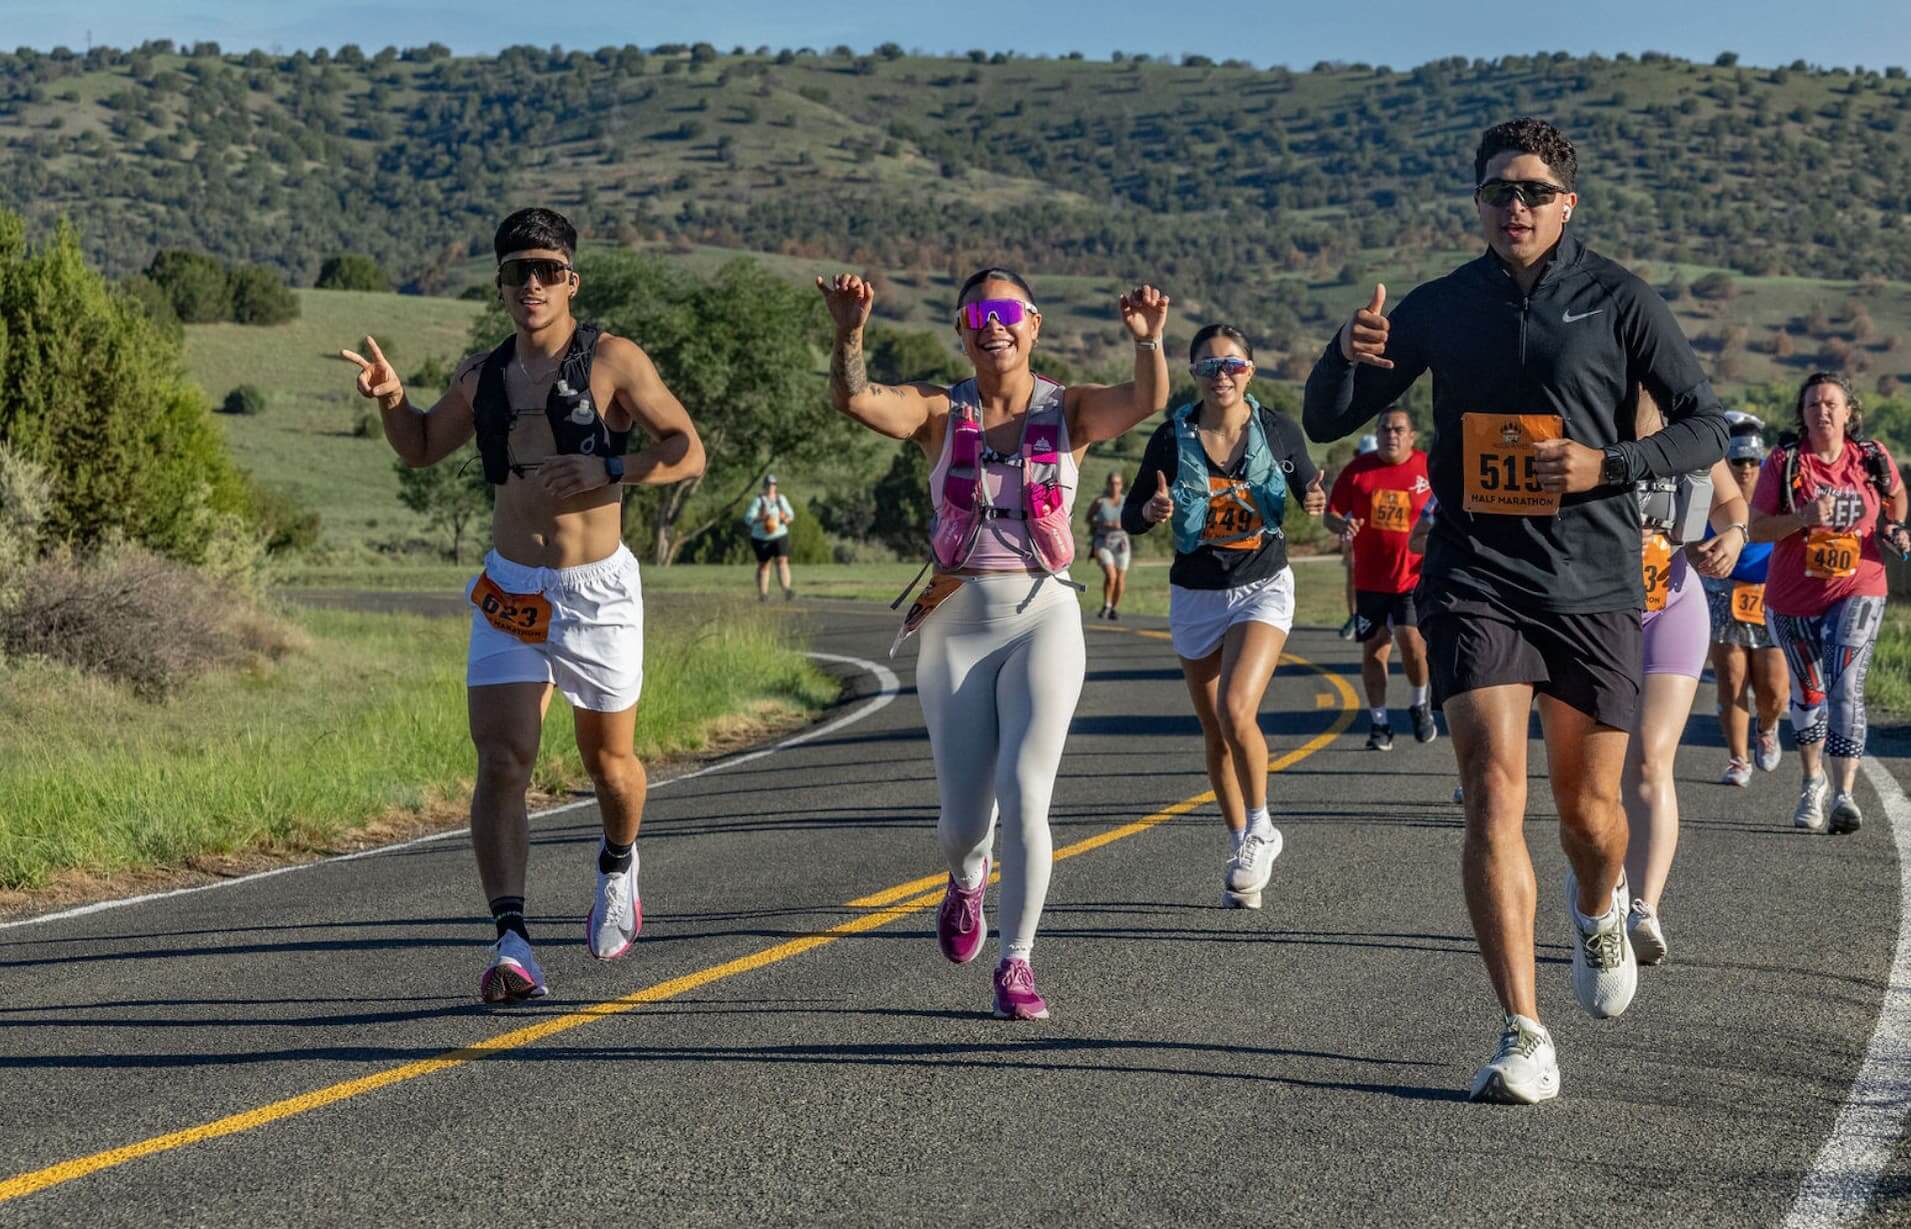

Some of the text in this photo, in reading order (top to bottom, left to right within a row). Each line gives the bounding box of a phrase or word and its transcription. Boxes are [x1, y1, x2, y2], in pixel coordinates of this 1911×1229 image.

[1479, 453, 1542, 492] 515
[1471, 494, 1554, 506] HALF MARATHON
[1377, 505, 1404, 522] 574
[1814, 548, 1851, 569] 480
[482, 593, 537, 627] 623
[1739, 593, 1764, 612] 37
